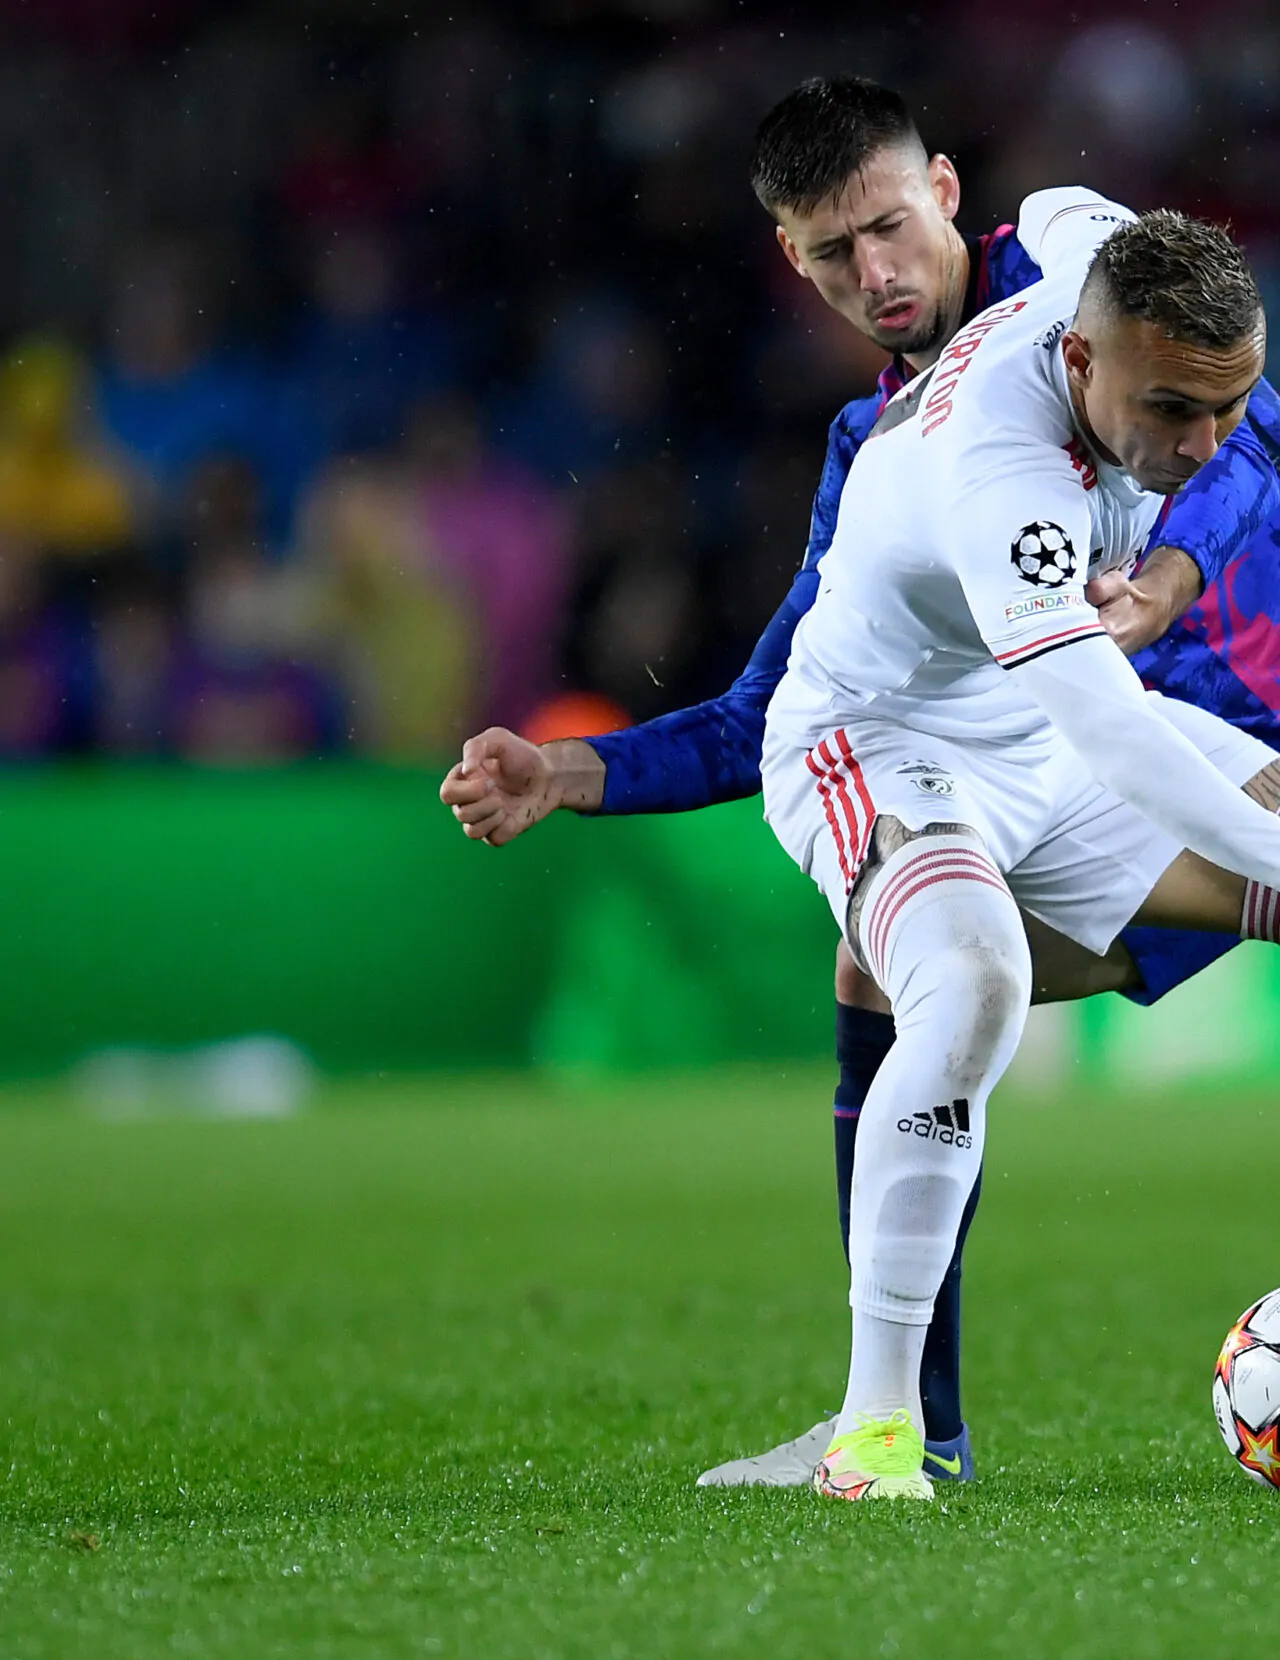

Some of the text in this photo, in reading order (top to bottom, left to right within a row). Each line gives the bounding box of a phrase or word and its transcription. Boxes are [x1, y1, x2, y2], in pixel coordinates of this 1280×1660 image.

[922, 301, 1028, 438] EVERTON
[1005, 595, 1085, 618] FOUNDATIO
[897, 1118, 972, 1149] adidas
